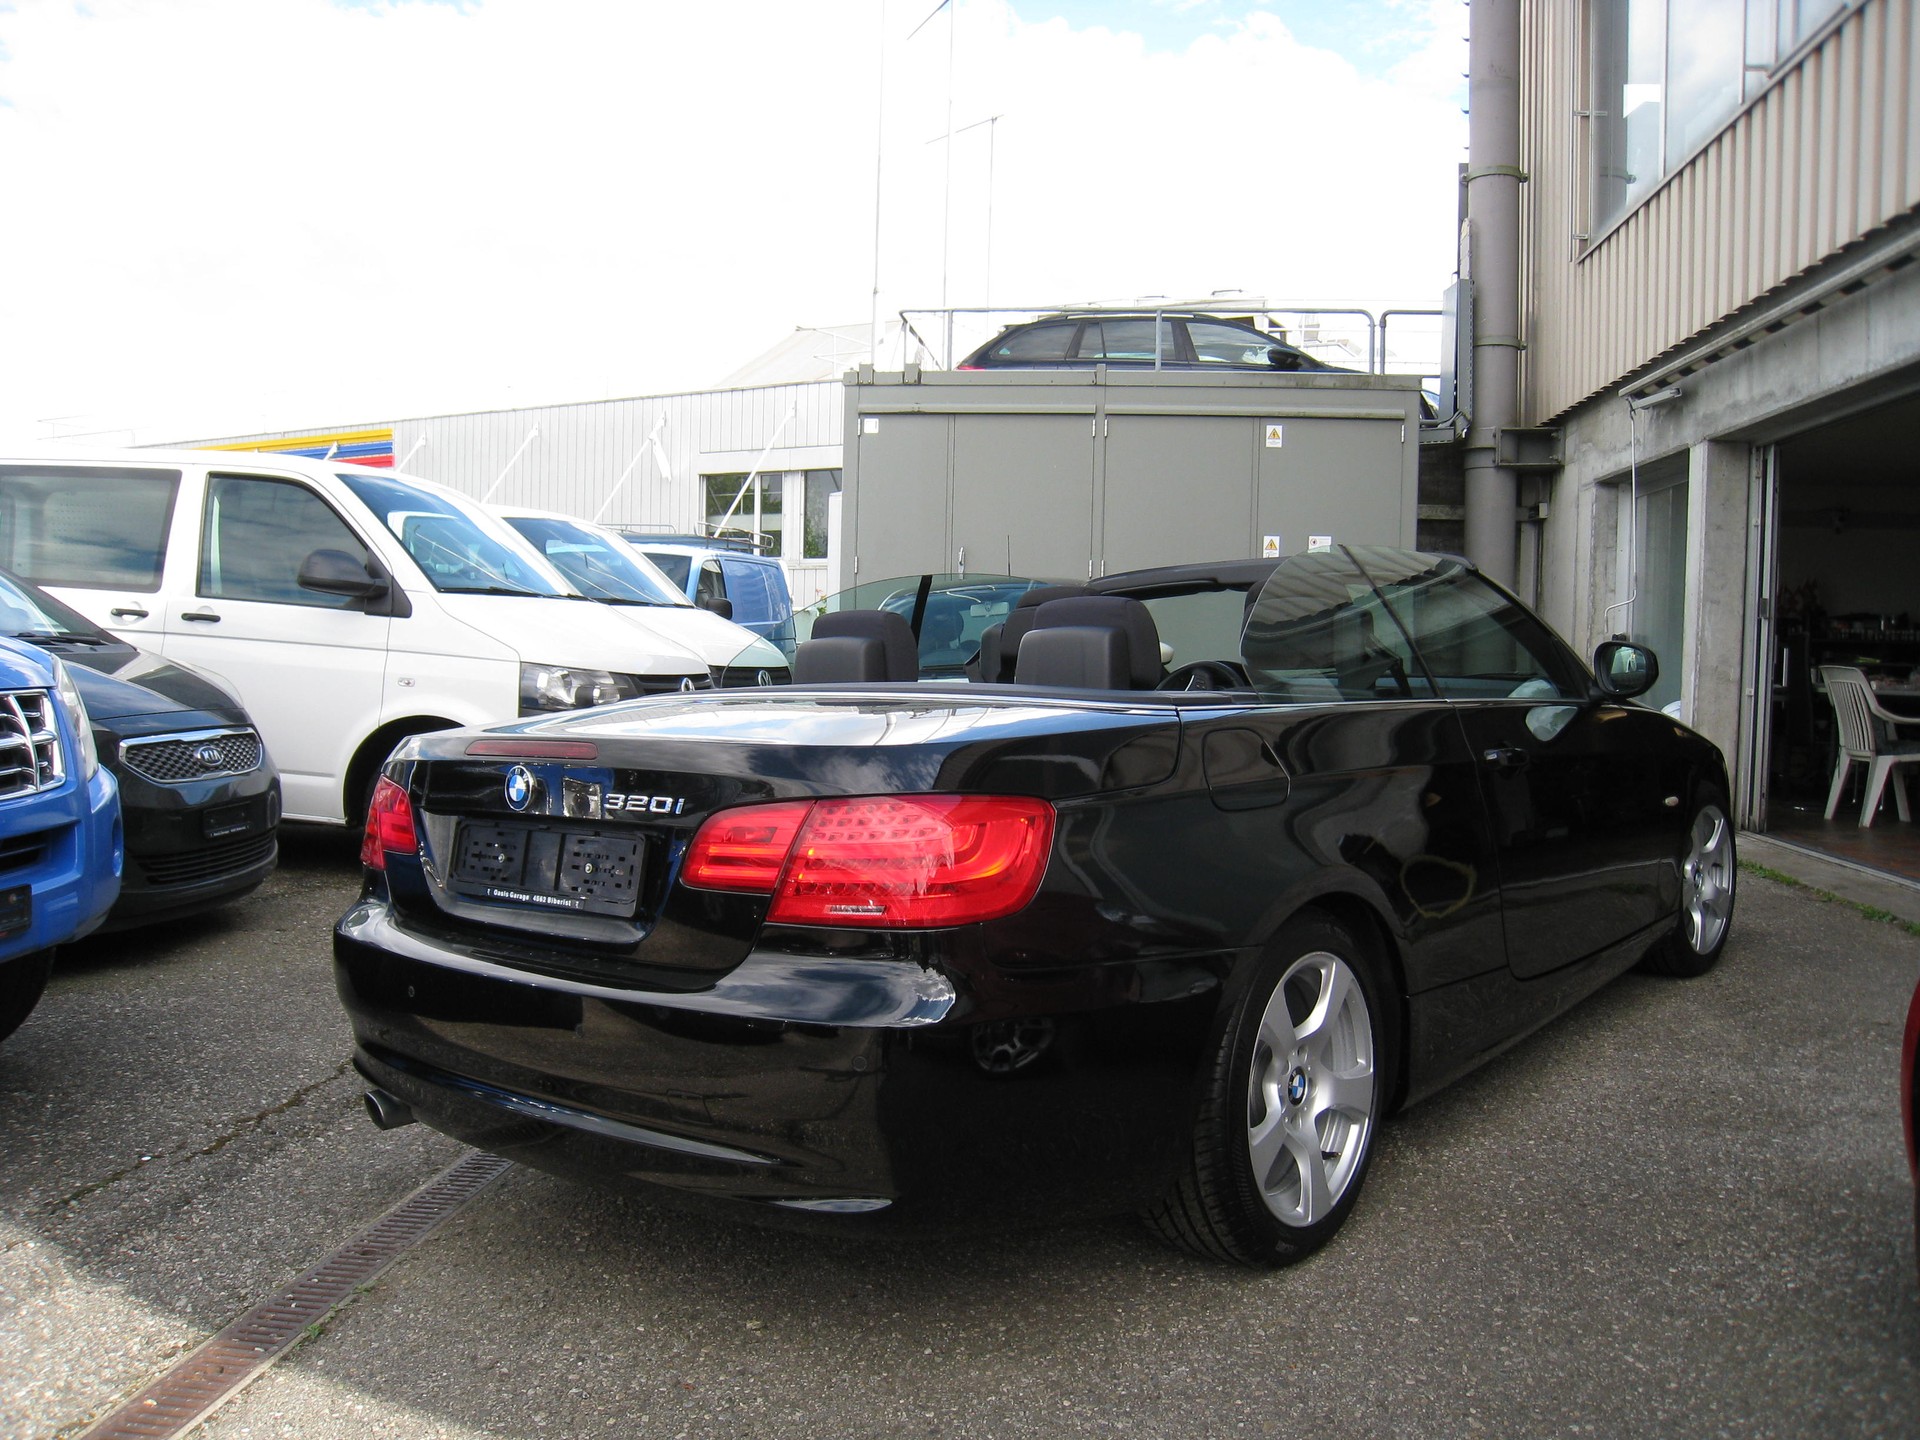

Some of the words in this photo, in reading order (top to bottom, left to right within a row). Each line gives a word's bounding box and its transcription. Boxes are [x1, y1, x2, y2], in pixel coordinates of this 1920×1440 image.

[201, 749, 221, 760] KIA
[603, 793, 685, 814] 320i
[493, 888, 509, 898] Oasis
[509, 891, 530, 901] Garage
[532, 894, 547, 903] 4562
[547, 896, 572, 907] Biberist
